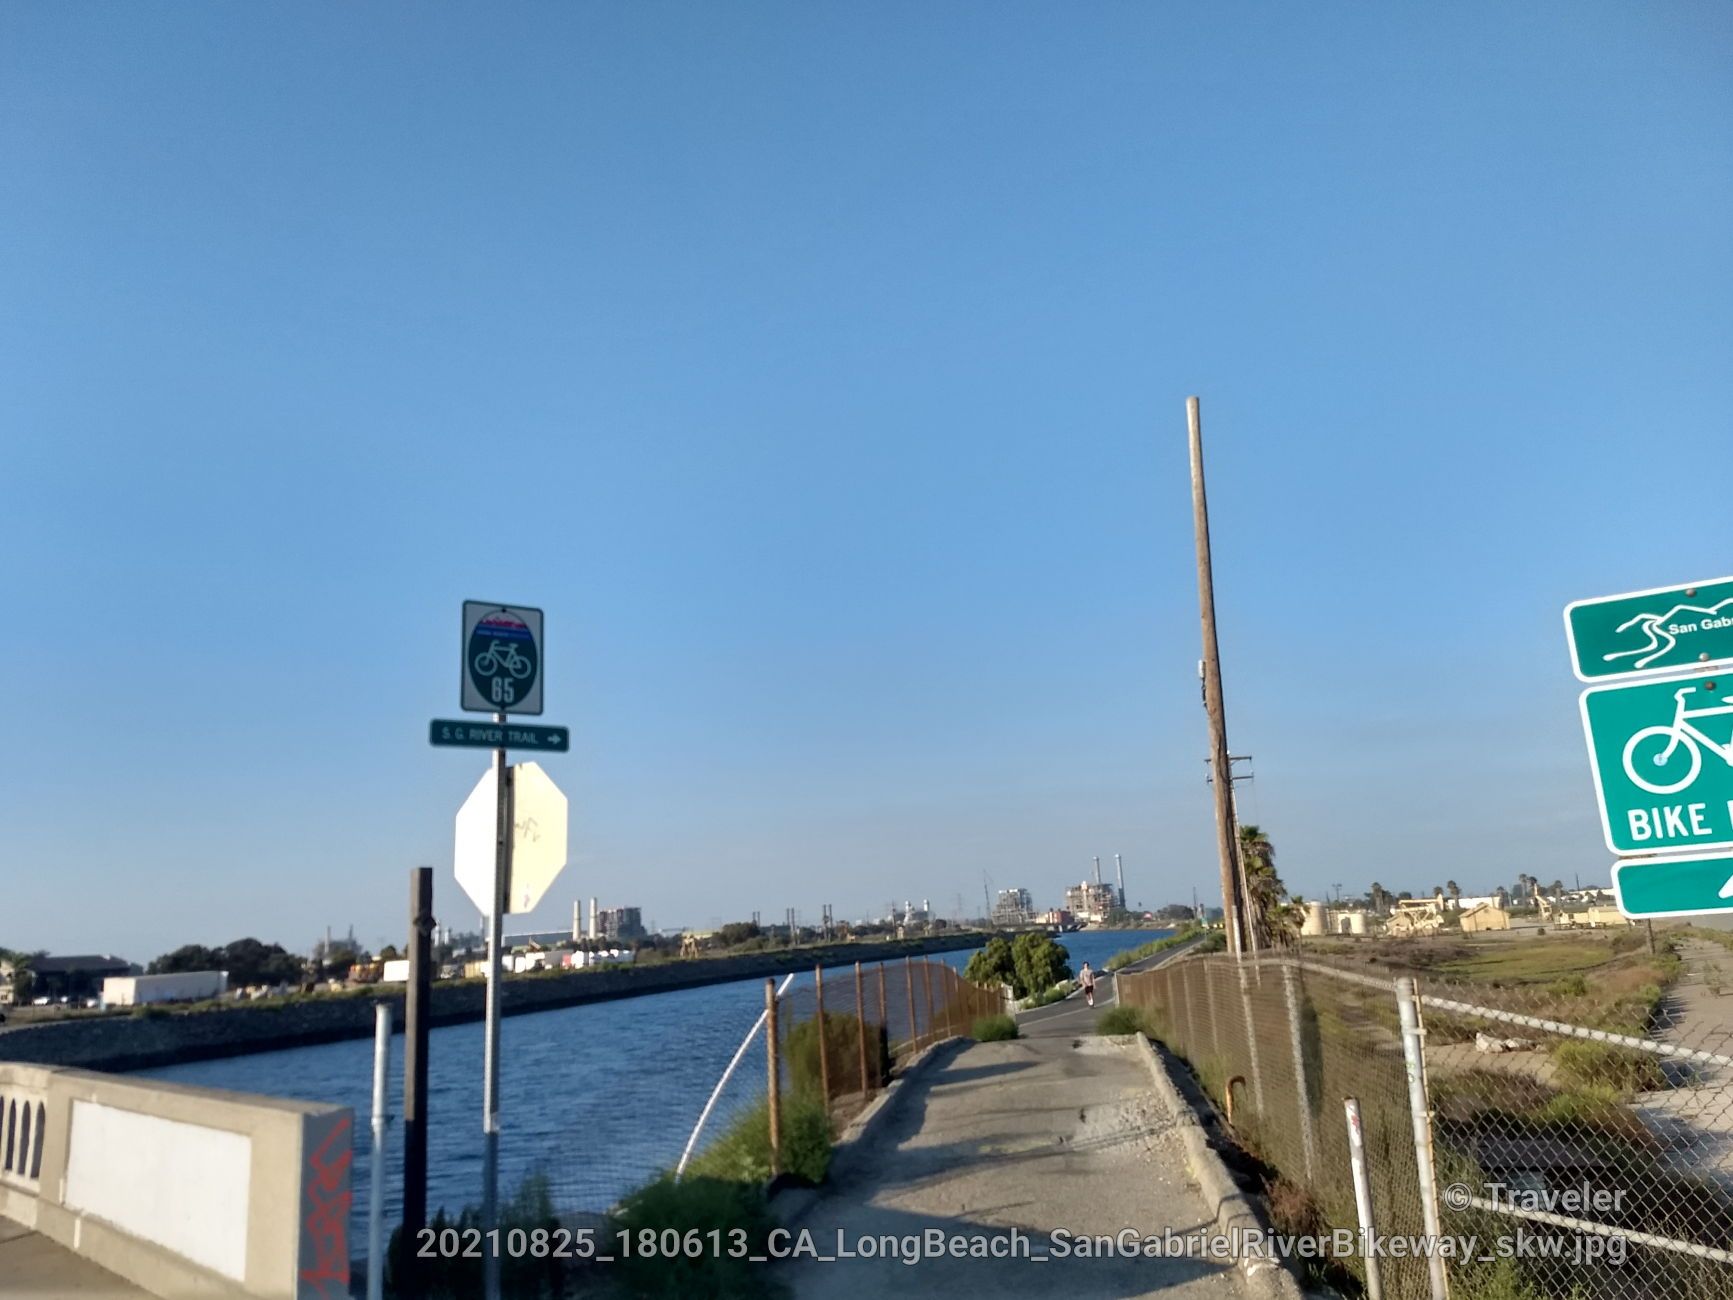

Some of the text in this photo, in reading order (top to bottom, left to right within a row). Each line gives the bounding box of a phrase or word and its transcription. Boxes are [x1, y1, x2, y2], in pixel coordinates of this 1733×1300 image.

[1668, 623, 1697, 635] San
[491, 677, 514, 702] 65
[469, 729, 502, 742] RIVER
[508, 731, 538, 744] TRAIL
[1627, 803, 1713, 841] BIKE
